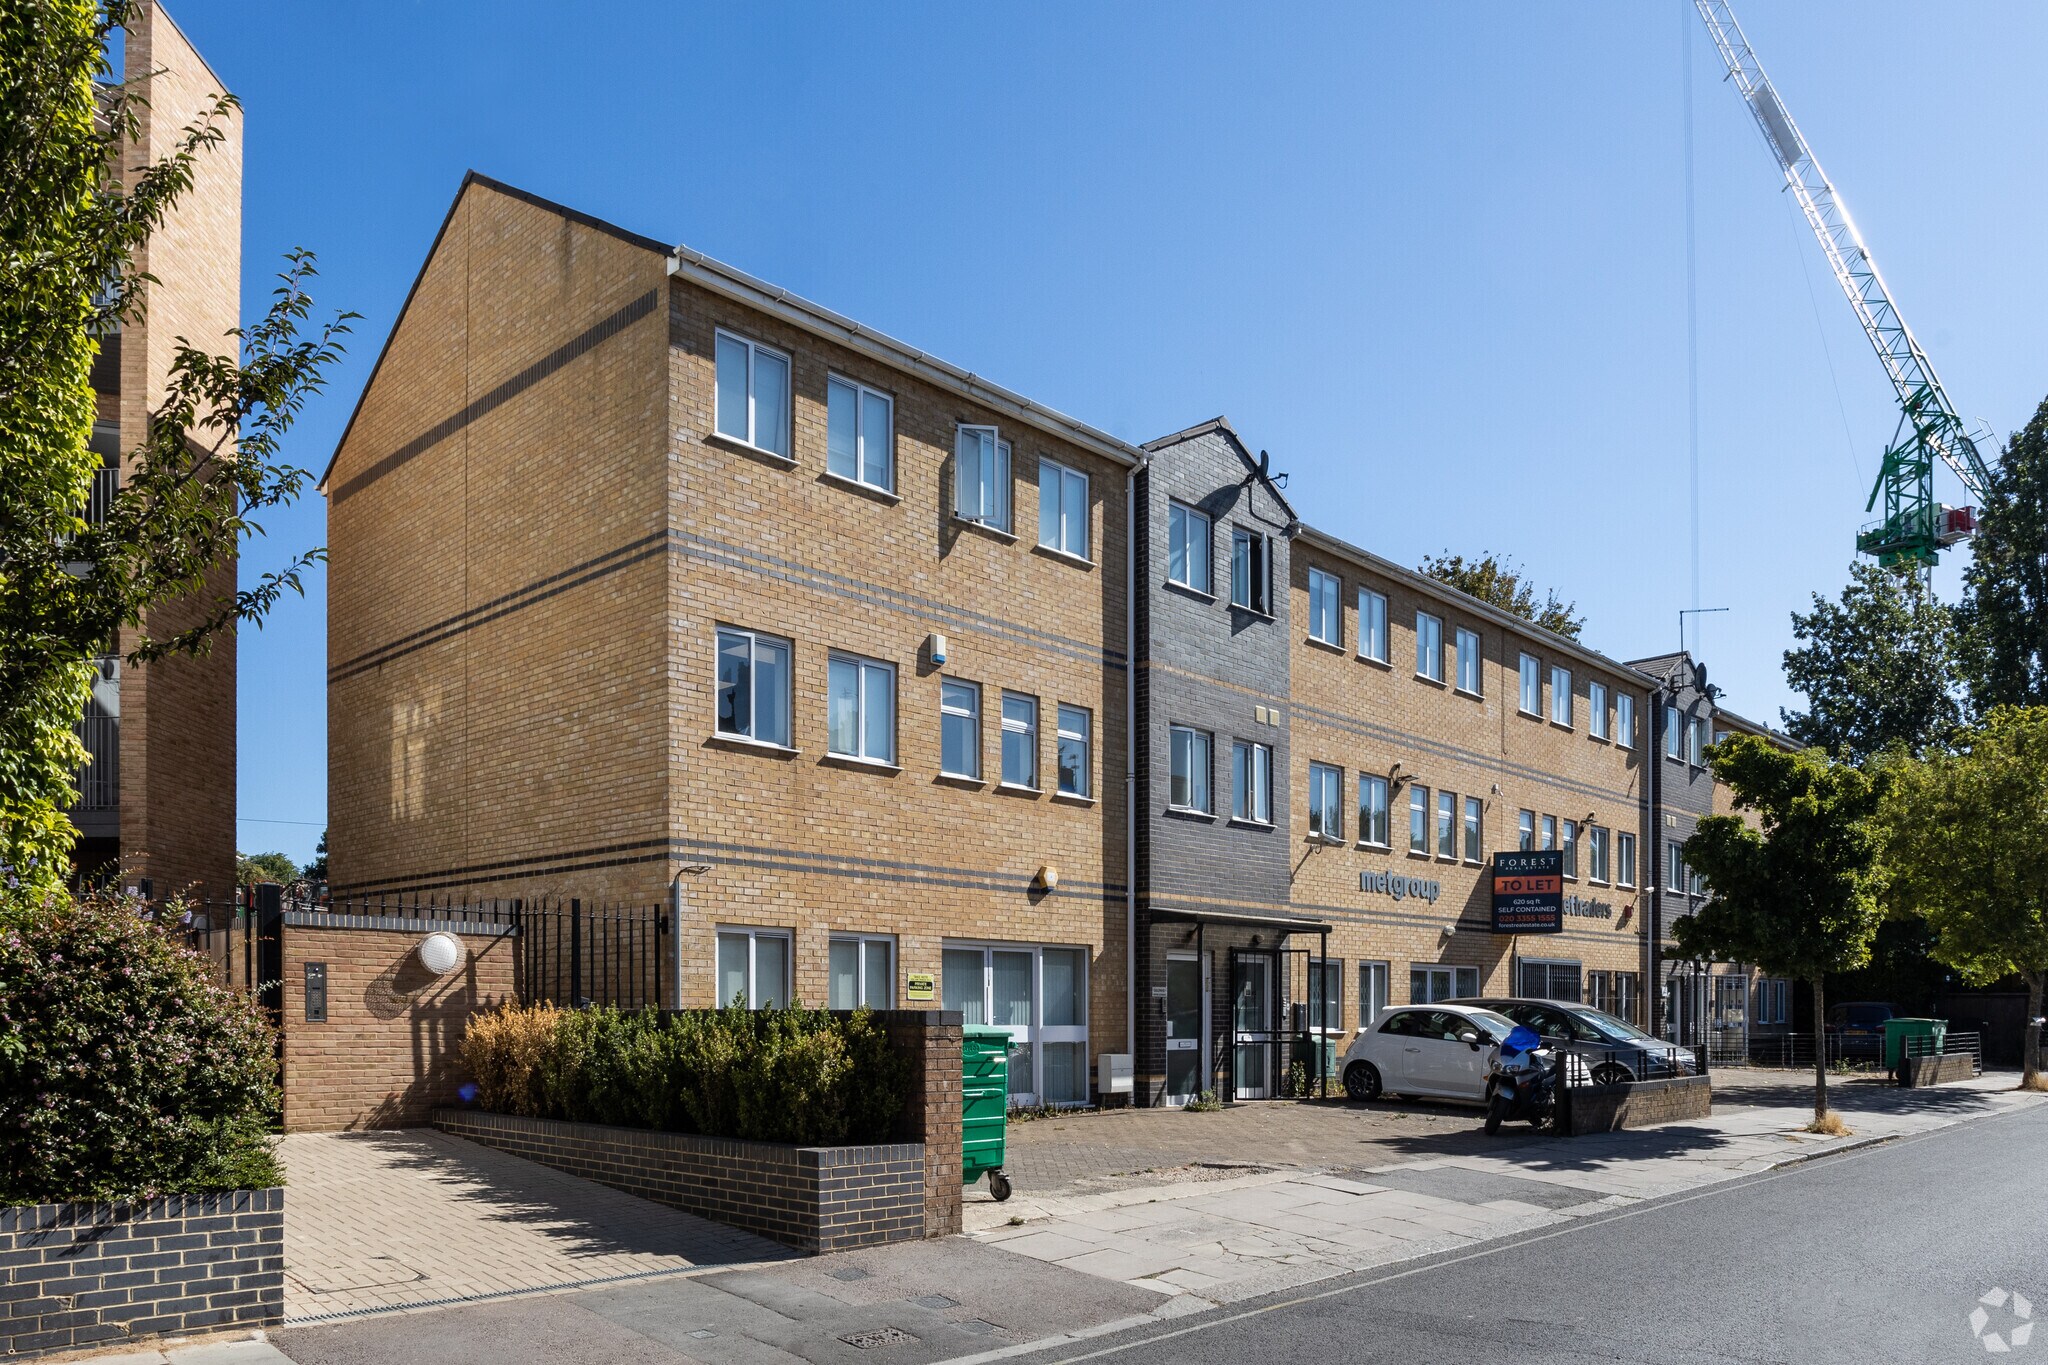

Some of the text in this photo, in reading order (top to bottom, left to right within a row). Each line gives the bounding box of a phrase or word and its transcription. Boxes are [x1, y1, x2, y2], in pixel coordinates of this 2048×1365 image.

[1500, 858, 1556, 866] FOREST
[1359, 868, 1440, 905] metgroup
[1502, 879, 1554, 891] TO LET
[1515, 905, 1557, 913] CONTAINED
[1562, 895, 1612, 919] ettraders
[1516, 914, 1536, 922] 3355
